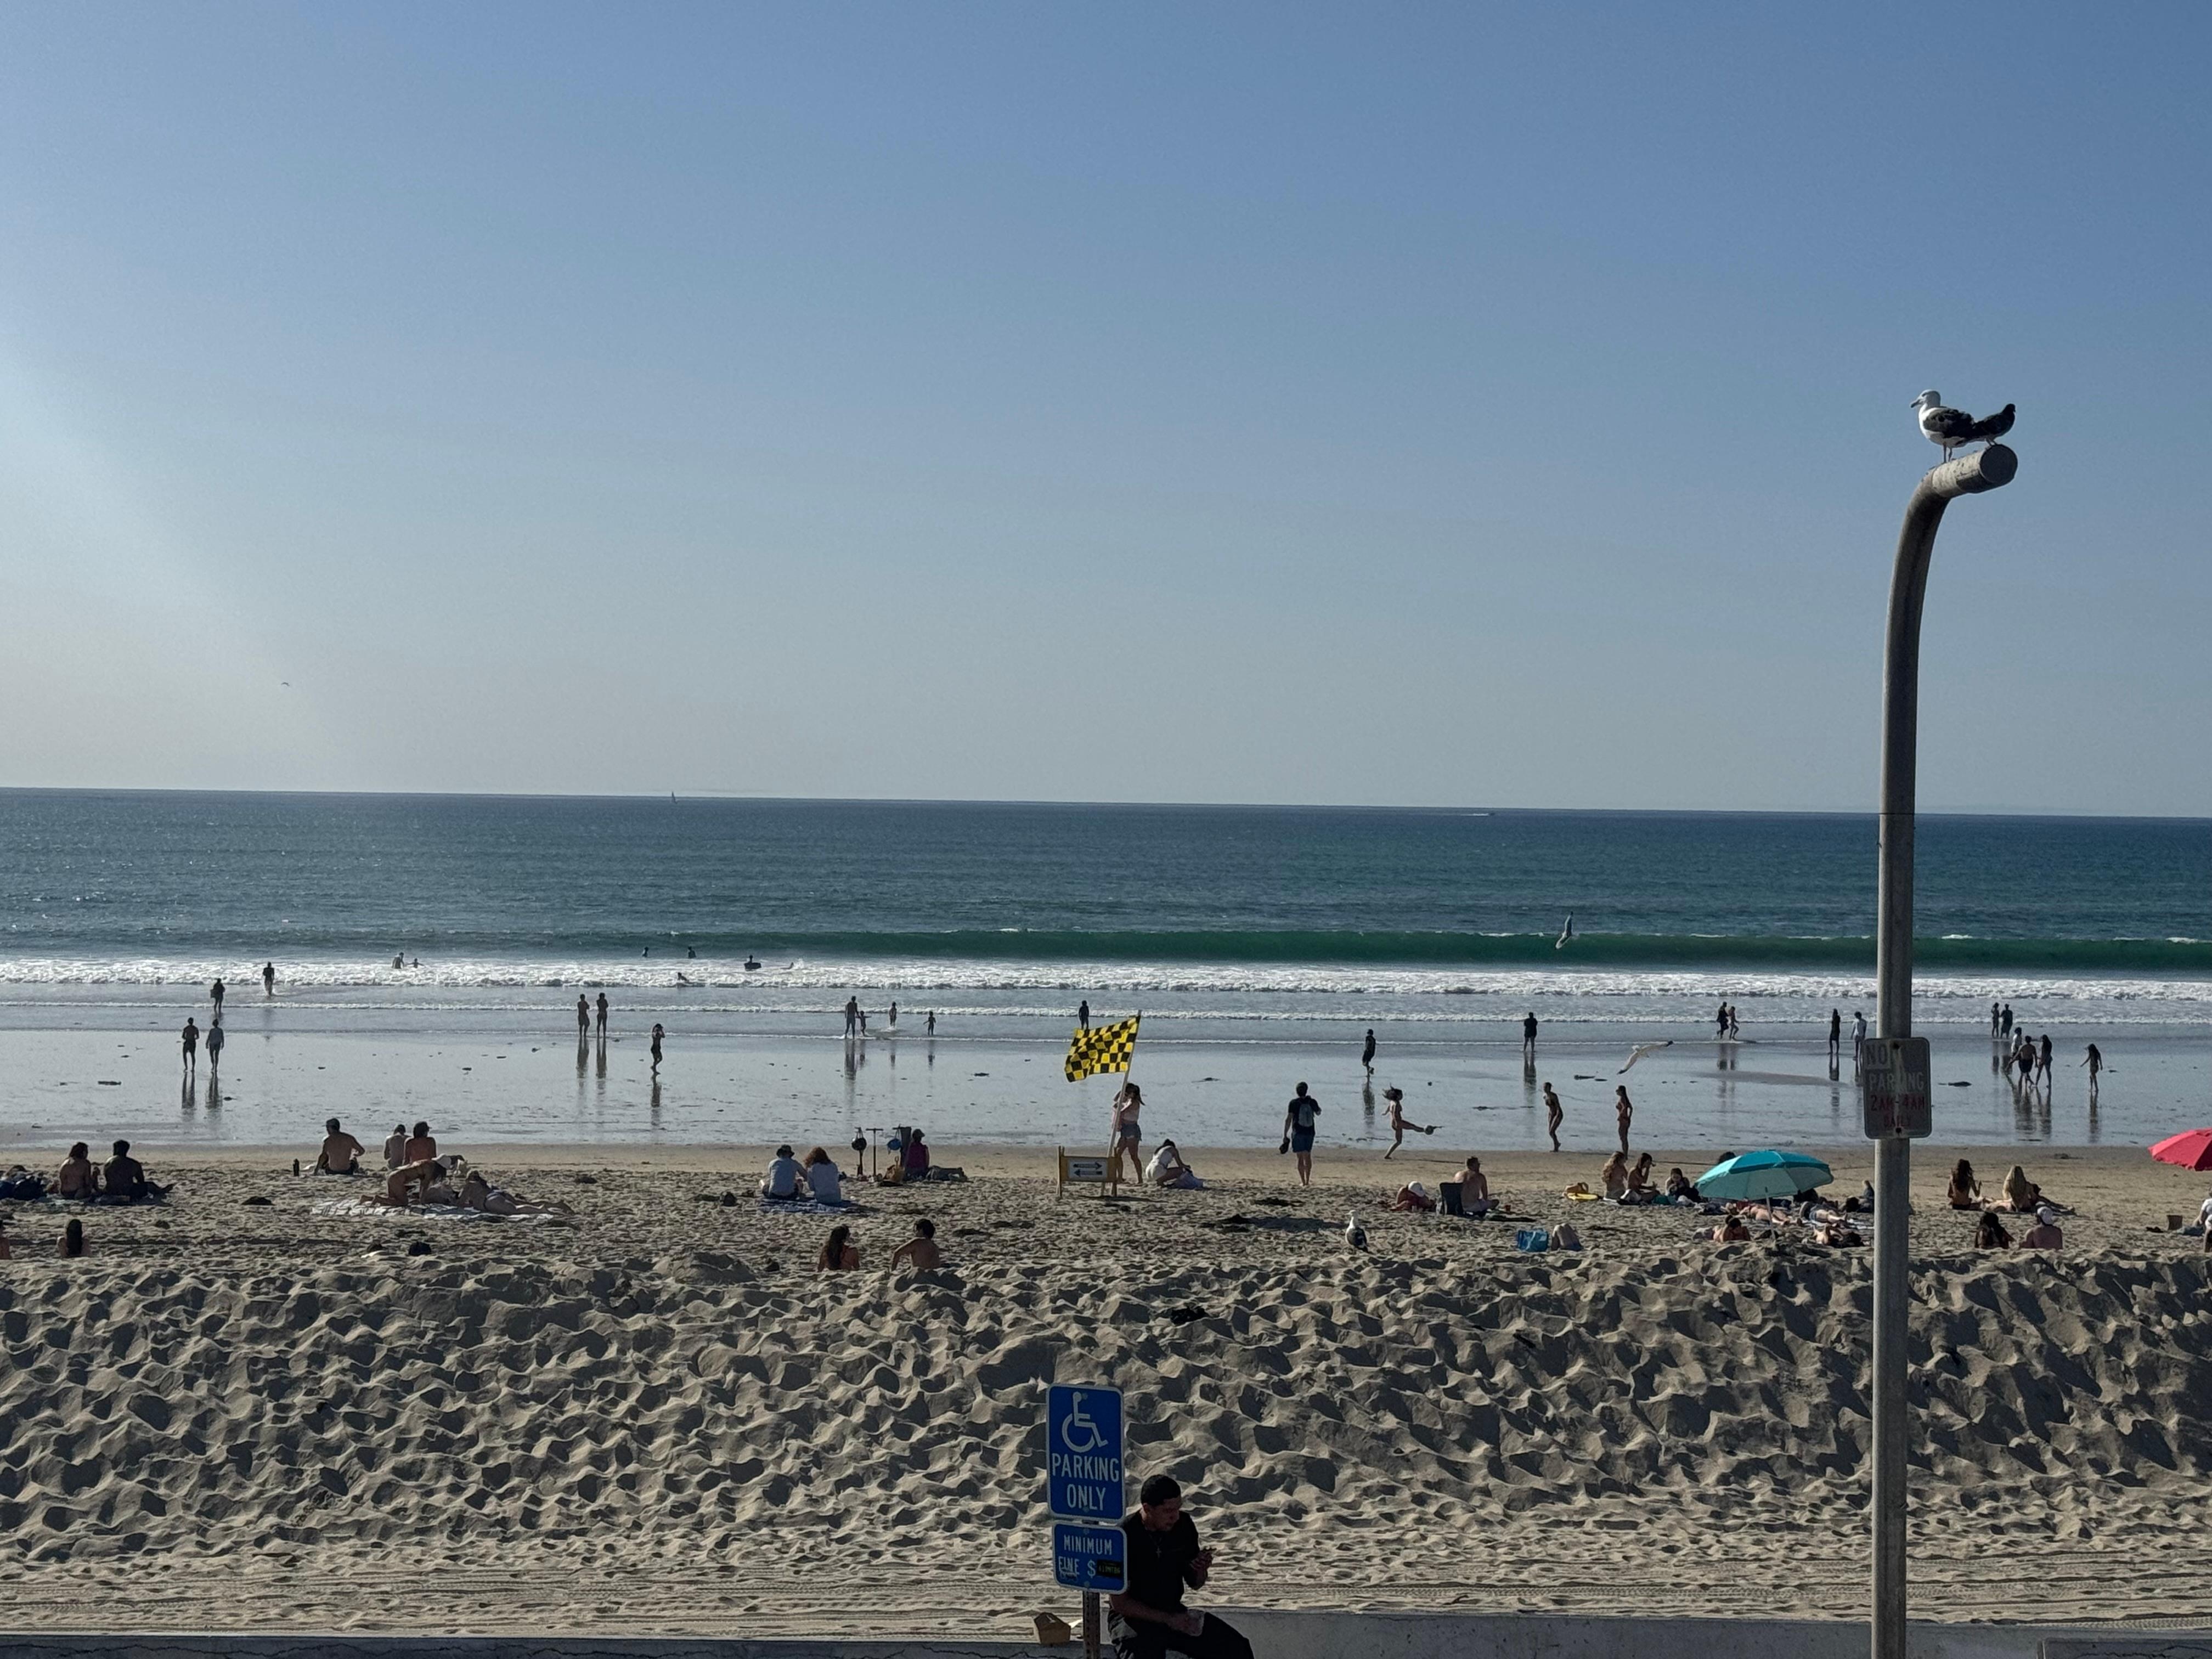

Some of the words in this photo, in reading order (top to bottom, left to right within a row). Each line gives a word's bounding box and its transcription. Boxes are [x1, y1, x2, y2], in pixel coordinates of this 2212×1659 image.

[1866, 1045, 1888, 1065] NO
[1052, 1453, 1119, 1482] PARKING
[1066, 1484, 1106, 1511] ONLY
[1064, 1534, 1112, 1555] MINIMUM
[1058, 1556, 1080, 1576] FINE
[1087, 1559, 1096, 1579] $
